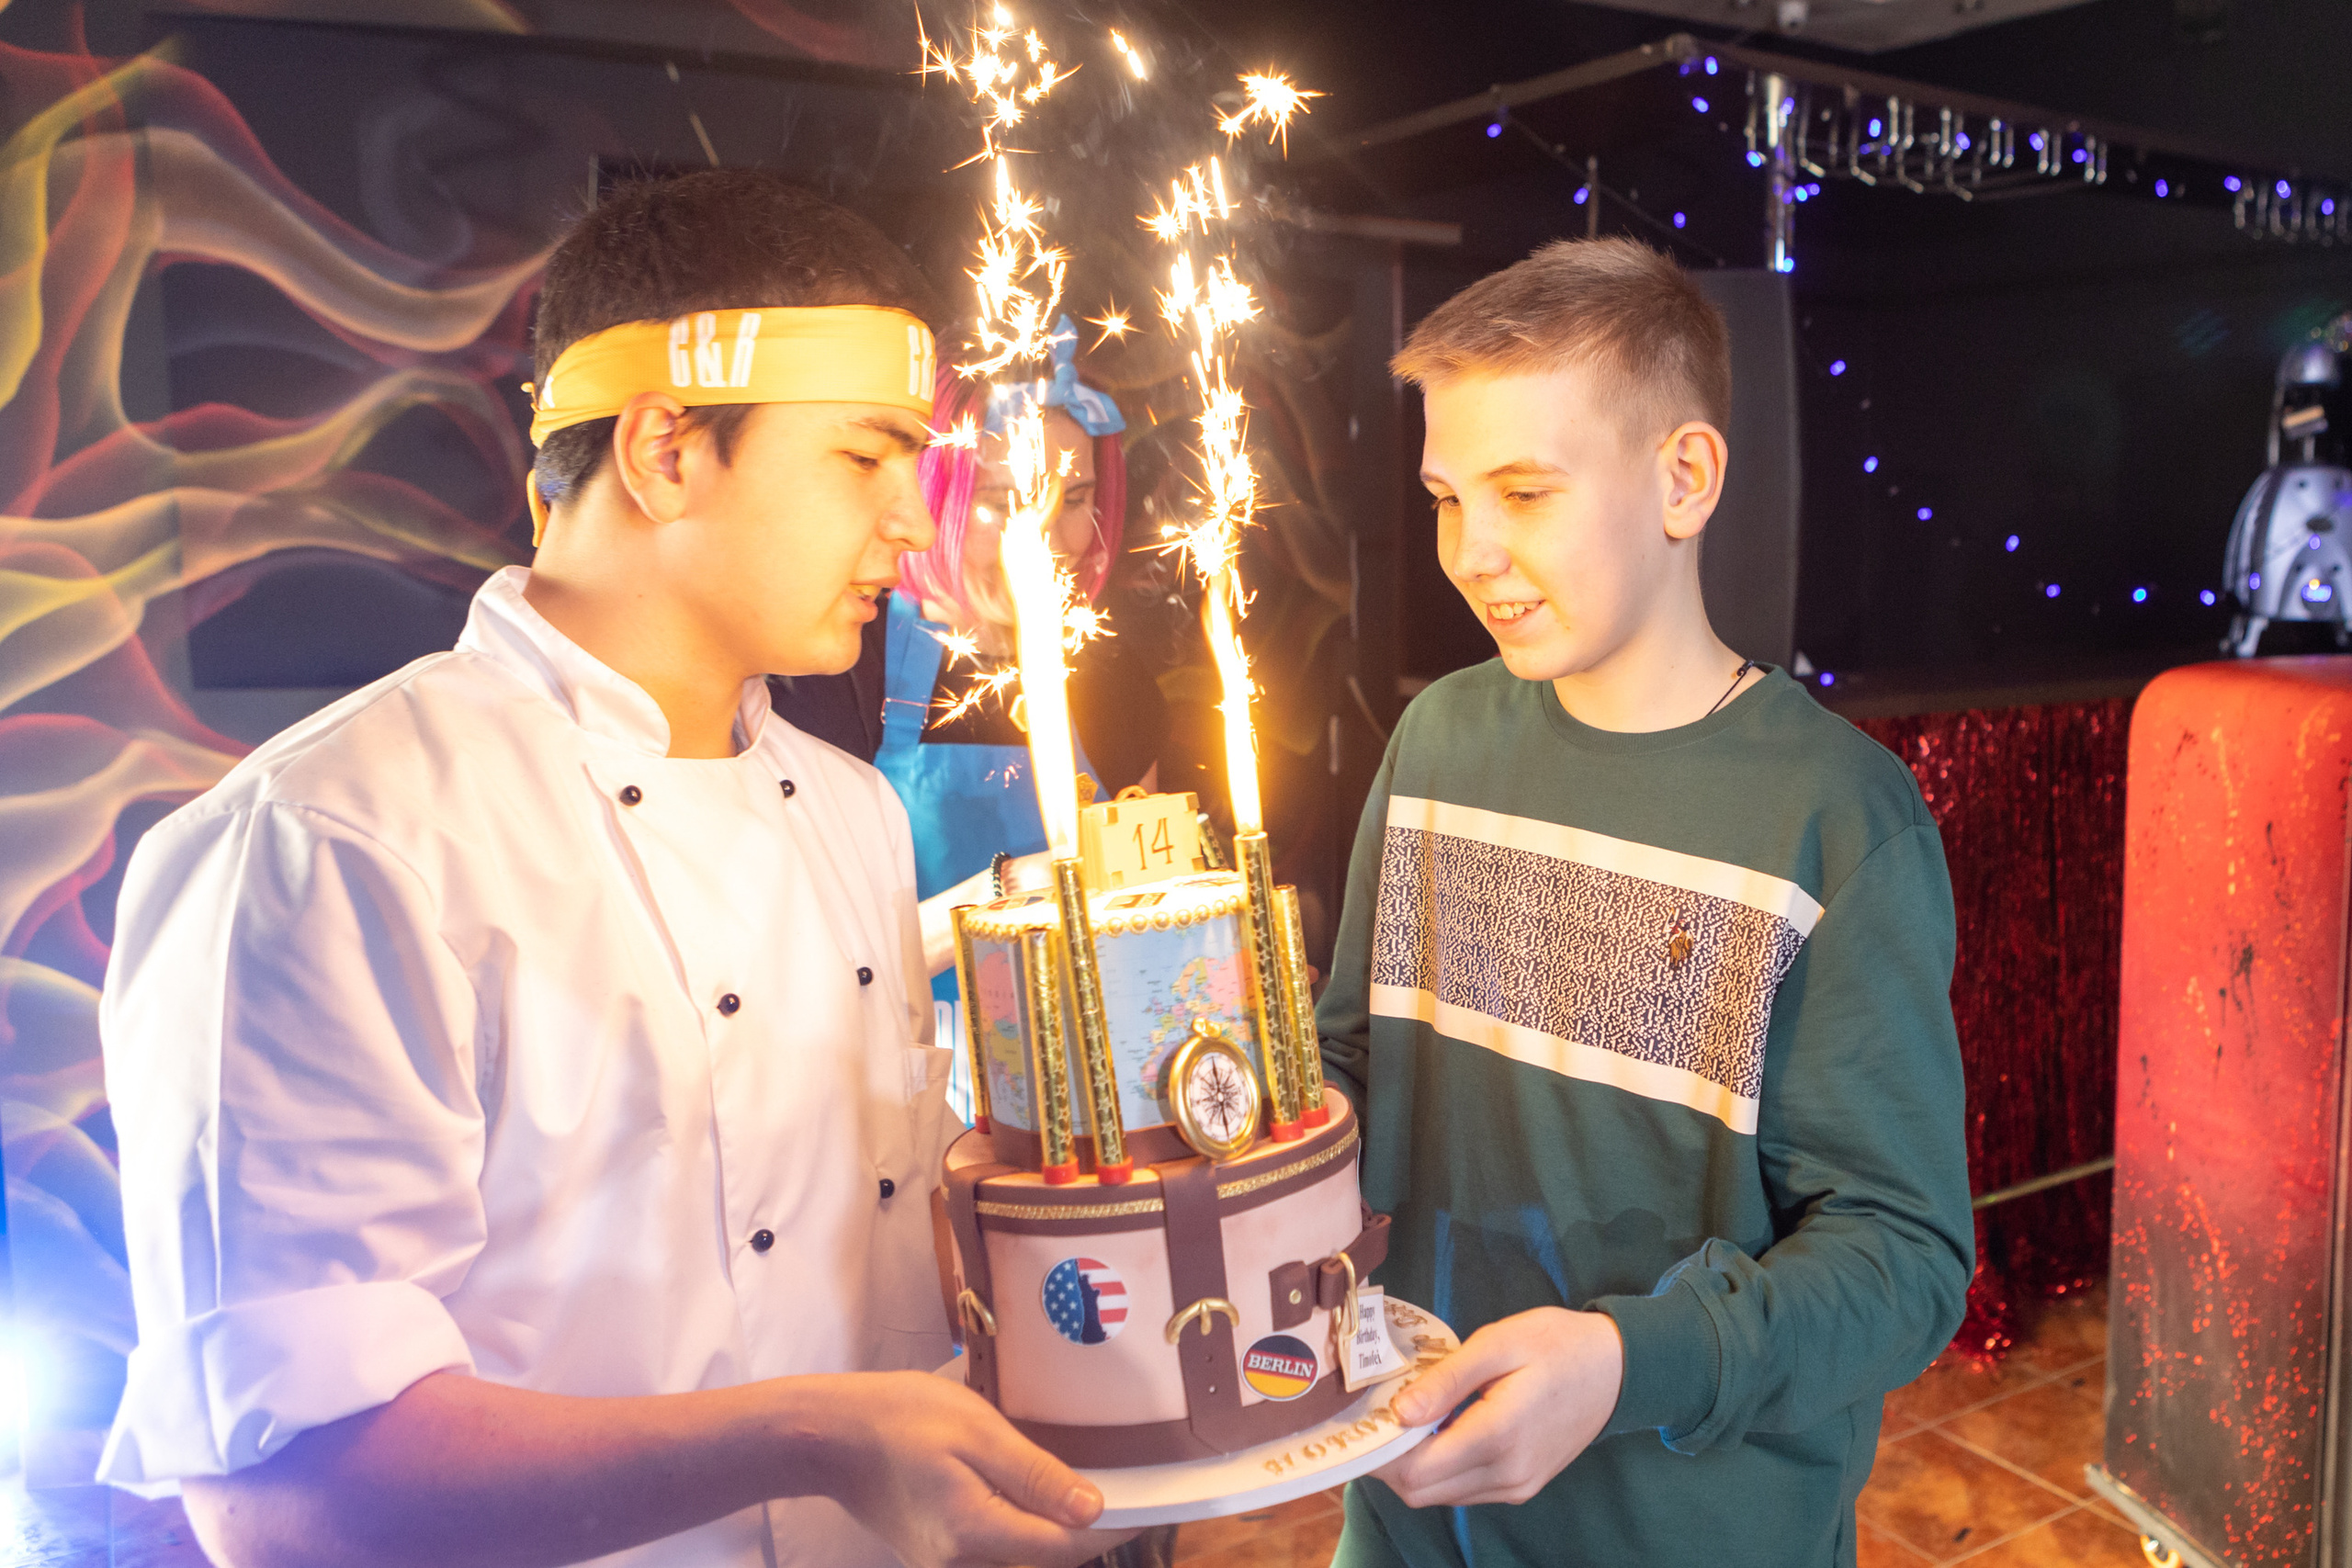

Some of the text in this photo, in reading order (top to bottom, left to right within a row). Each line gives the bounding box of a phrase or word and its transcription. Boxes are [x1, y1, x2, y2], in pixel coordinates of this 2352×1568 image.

[1132, 817, 1175, 871] 14
[1360, 1304, 1375, 1323] Happy
[1248, 1354, 1314, 1378] BERLIN
